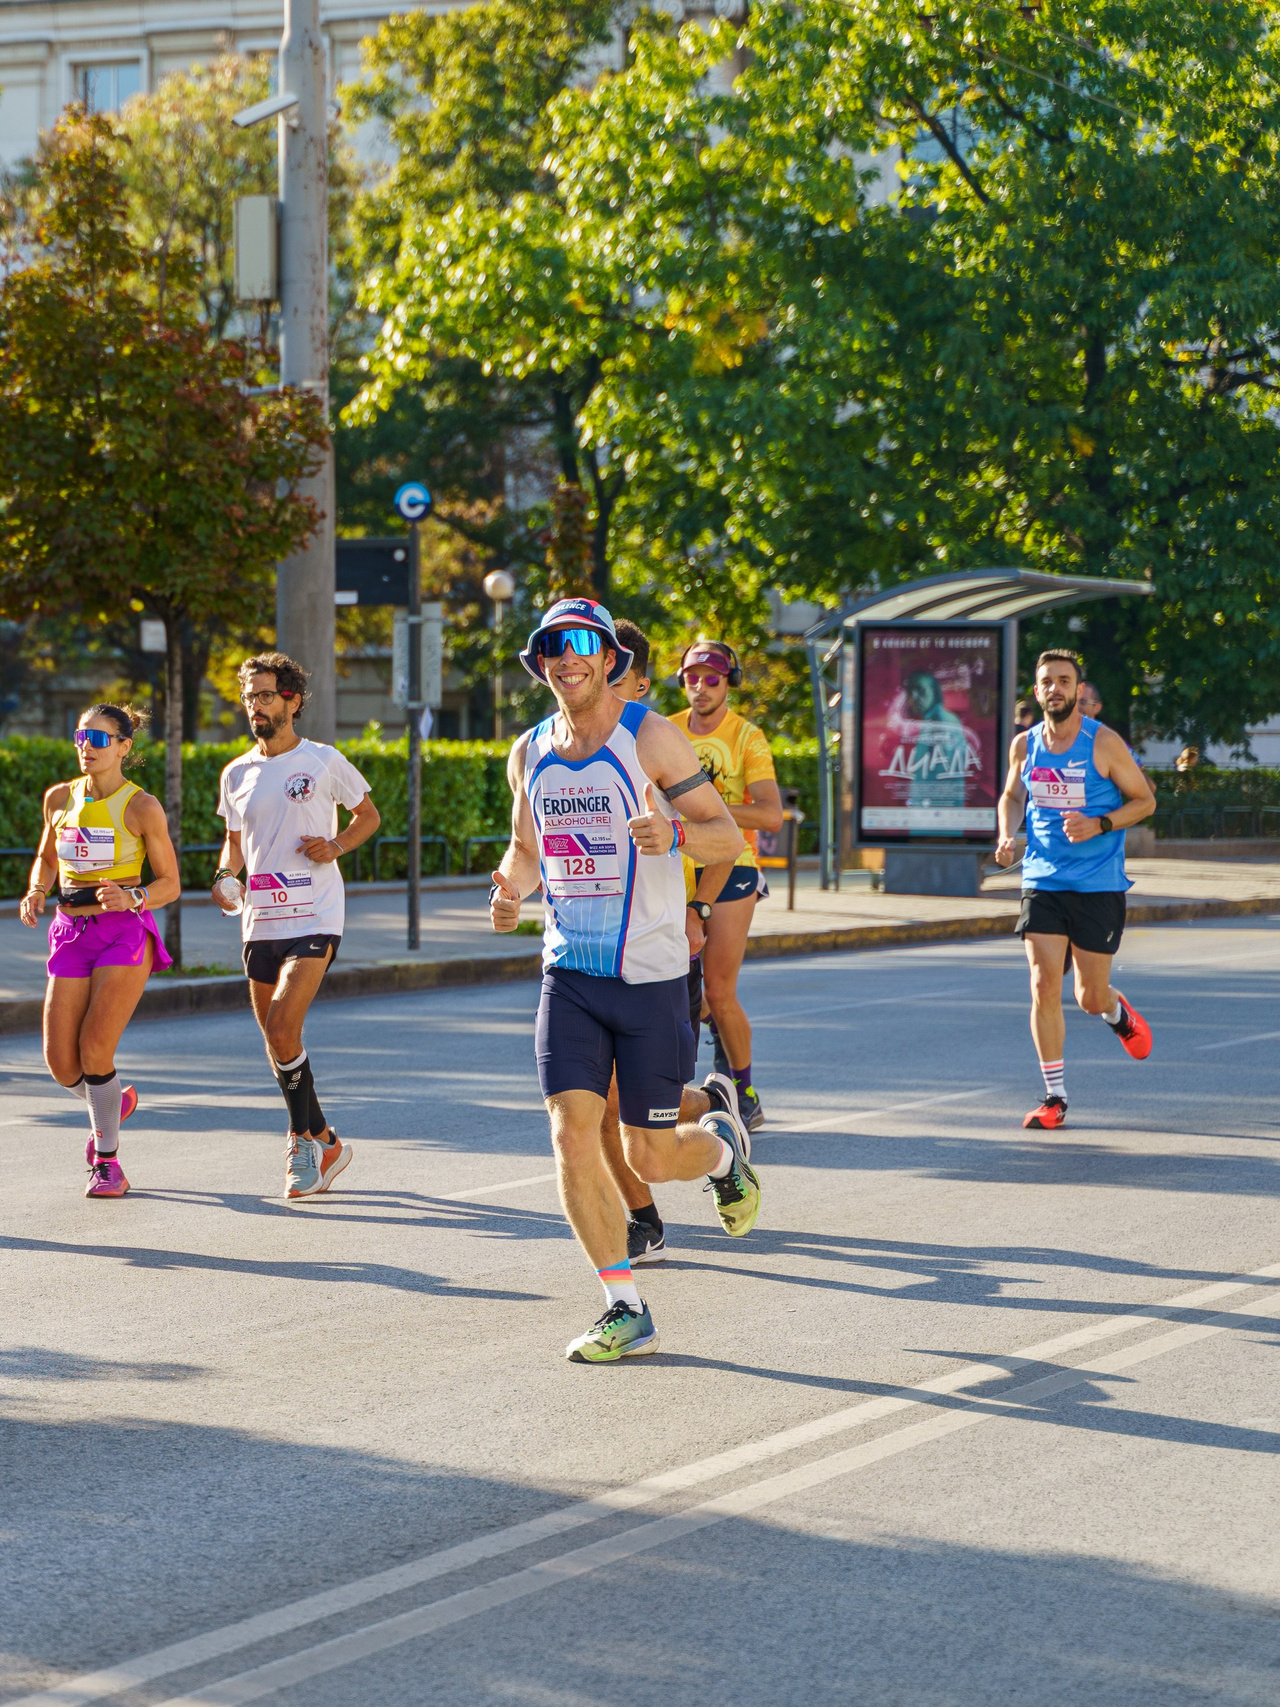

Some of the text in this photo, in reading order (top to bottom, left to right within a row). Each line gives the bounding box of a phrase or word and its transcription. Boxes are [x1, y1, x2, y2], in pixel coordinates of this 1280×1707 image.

[878, 743, 983, 781] ДИАДА
[560, 786, 594, 796] TEAM
[1045, 784, 1068, 795] 193
[543, 796, 612, 816] ERDINGER
[544, 816, 612, 827] ALKOHOLFREI
[74, 845, 89, 858] 15
[563, 857, 596, 875] 128
[271, 891, 288, 903] 10
[652, 1111, 679, 1119] SAYSK
